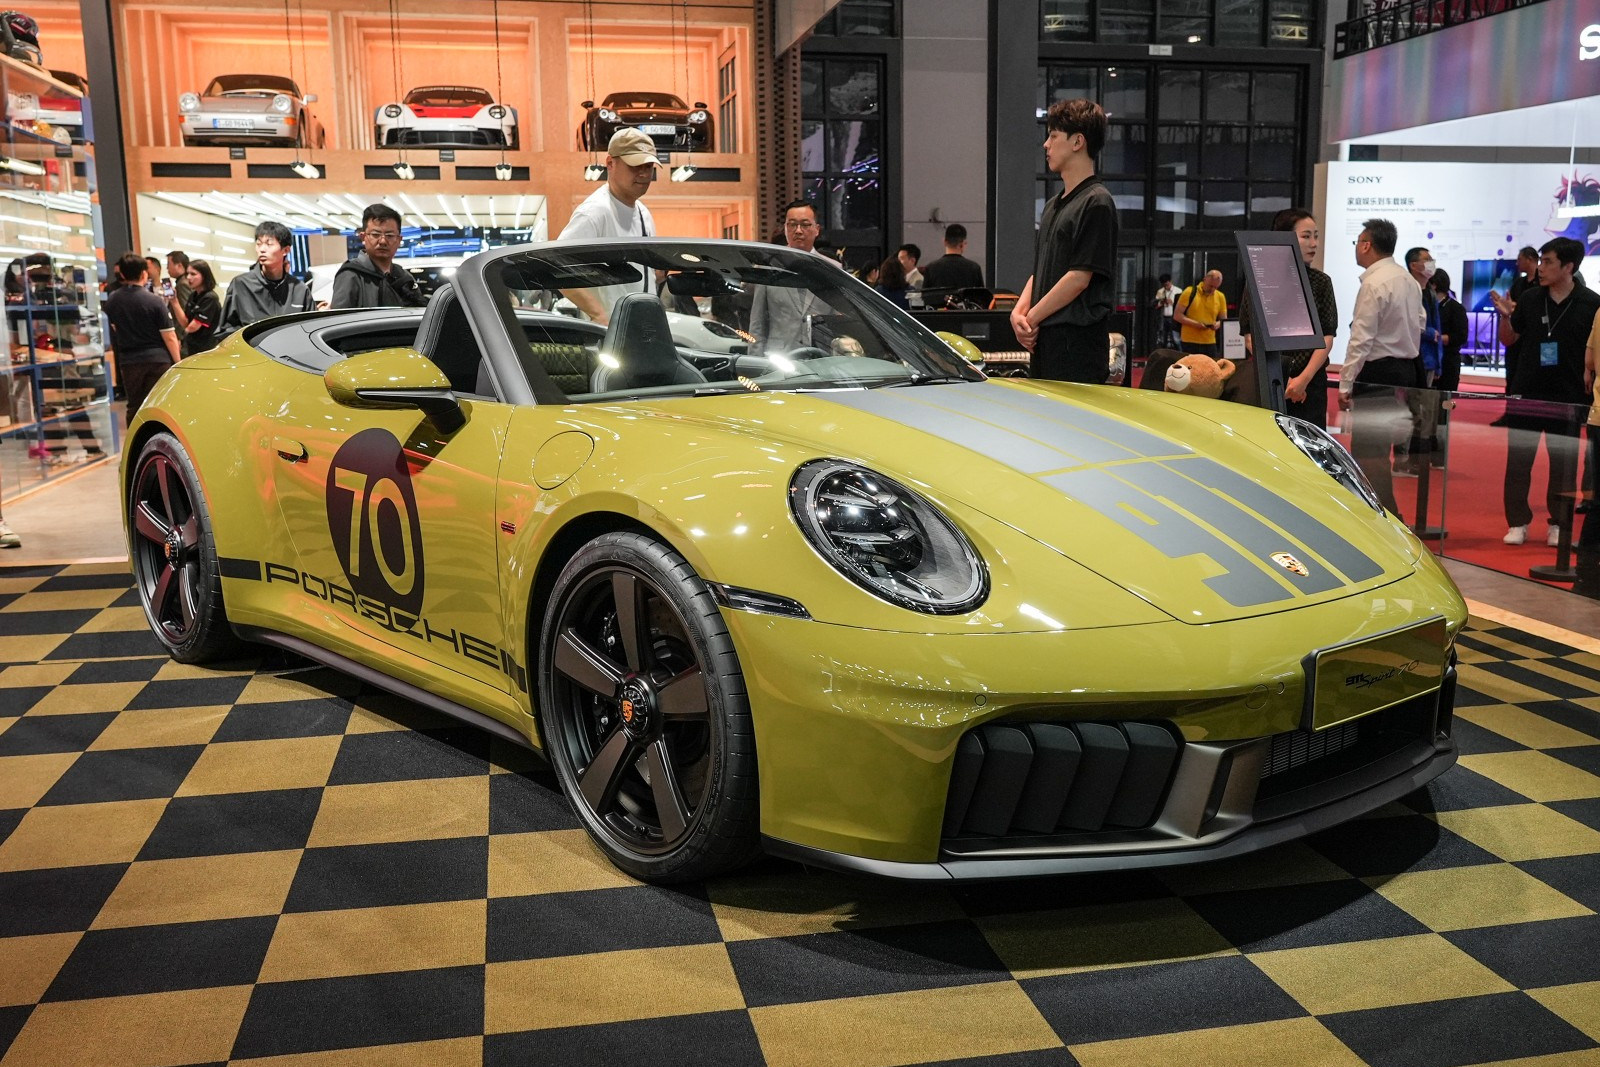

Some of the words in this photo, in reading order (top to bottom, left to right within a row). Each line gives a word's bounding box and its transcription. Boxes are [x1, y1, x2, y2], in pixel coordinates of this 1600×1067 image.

[1348, 176, 1383, 184] SONY
[334, 466, 415, 596] 70
[266, 563, 500, 671] PORSCHE
[1397, 659, 1420, 676] 70
